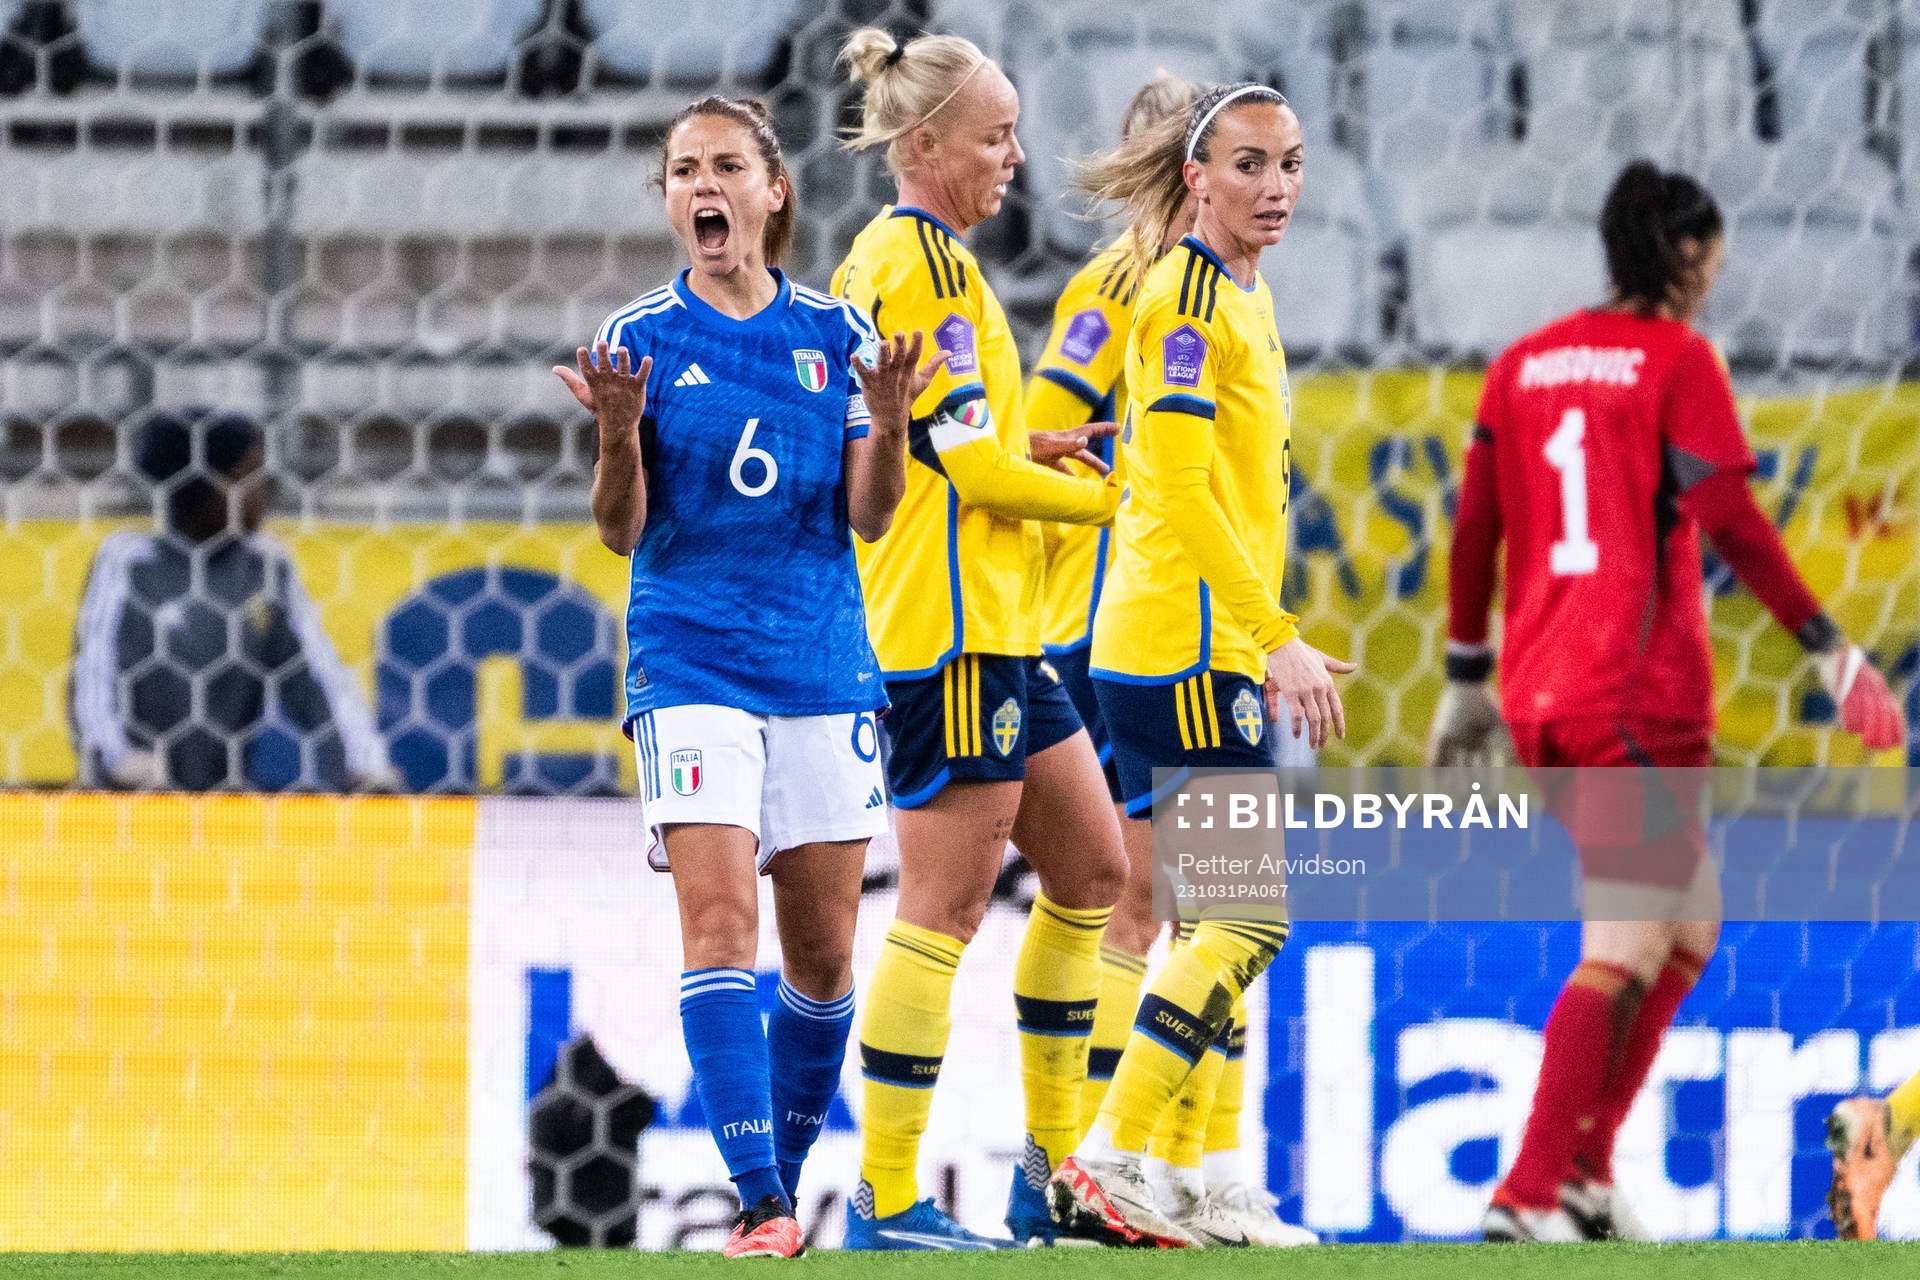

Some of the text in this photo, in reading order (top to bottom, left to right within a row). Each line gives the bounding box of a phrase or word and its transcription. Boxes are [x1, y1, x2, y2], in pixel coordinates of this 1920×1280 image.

[796, 352, 822, 361] ITALIA
[1167, 365, 1197, 374] NATIONS
[1168, 370, 1195, 379] LEAGUE
[729, 417, 779, 497] 6
[1543, 406, 1599, 576] 1
[851, 711, 879, 764] 6
[672, 752, 700, 764] ITALIA
[723, 1118, 773, 1141] ITALIA
